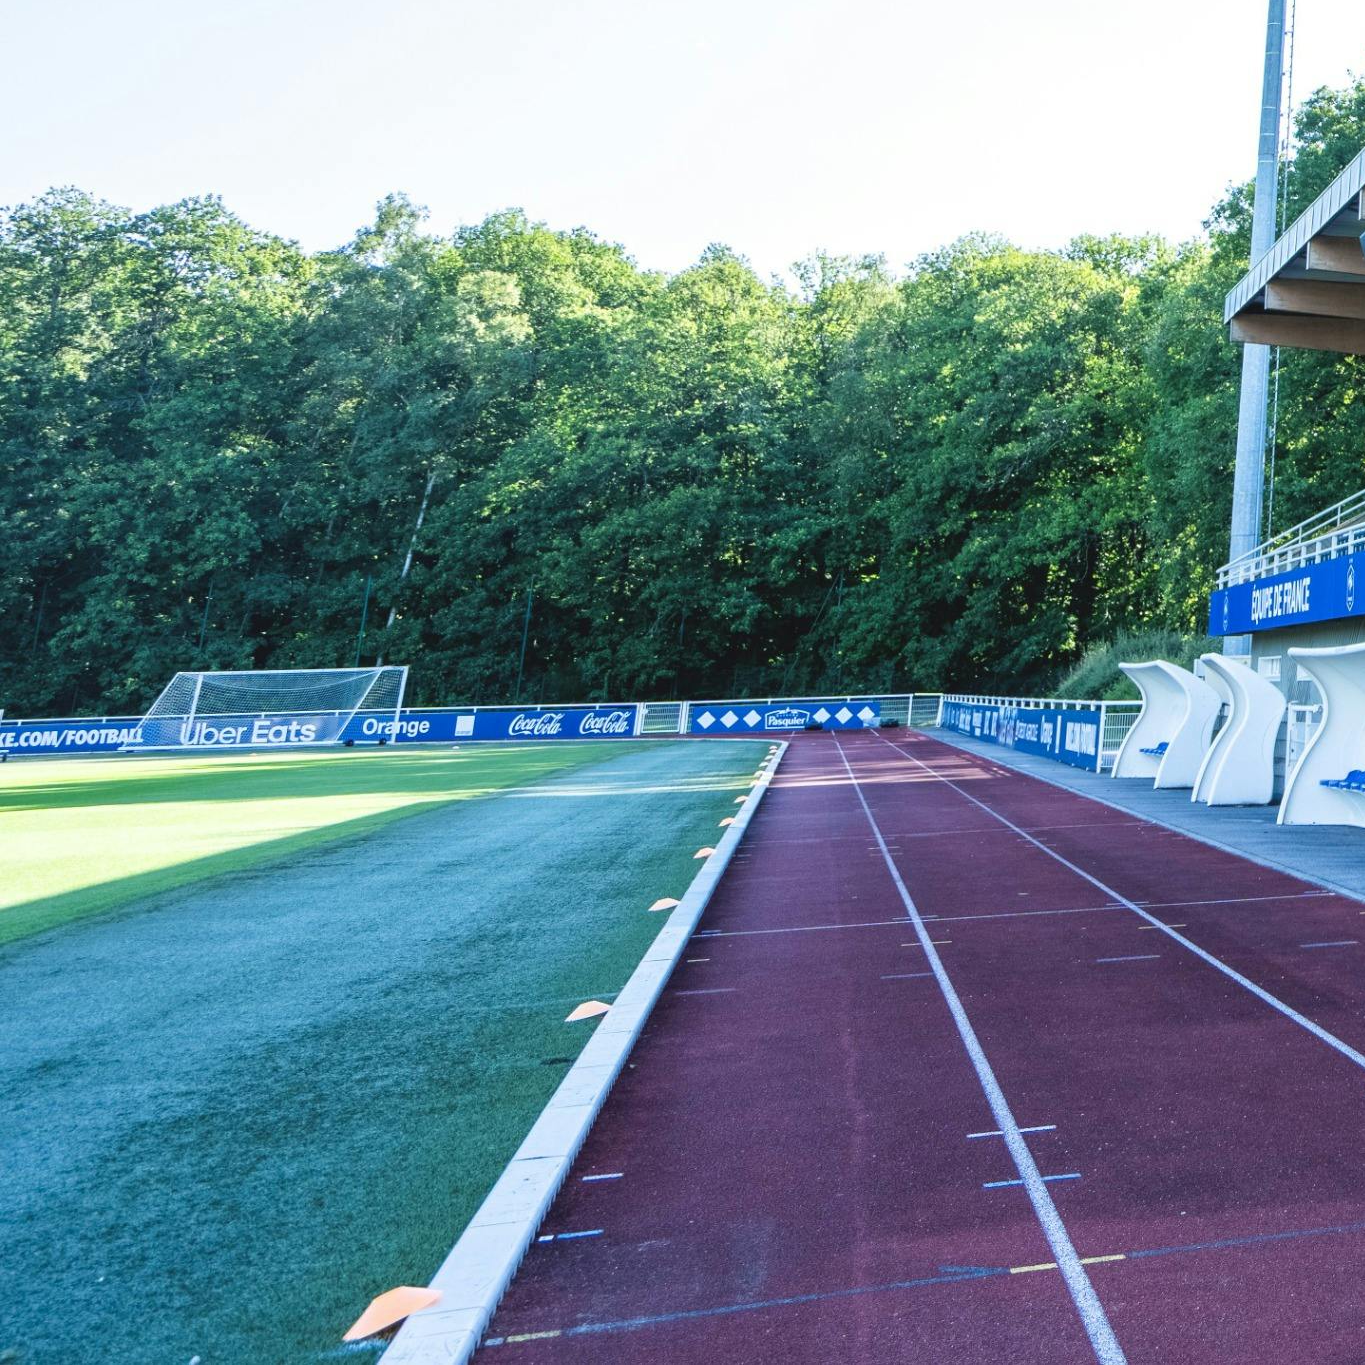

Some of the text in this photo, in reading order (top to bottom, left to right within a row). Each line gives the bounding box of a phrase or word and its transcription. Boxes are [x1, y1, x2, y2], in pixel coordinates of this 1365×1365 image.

[1251, 577, 1310, 625] ÉQUIPE DE FRANCE
[362, 718, 430, 737] Orange
[768, 715, 805, 727] Pasquier
[180, 720, 316, 745] Uber Eats
